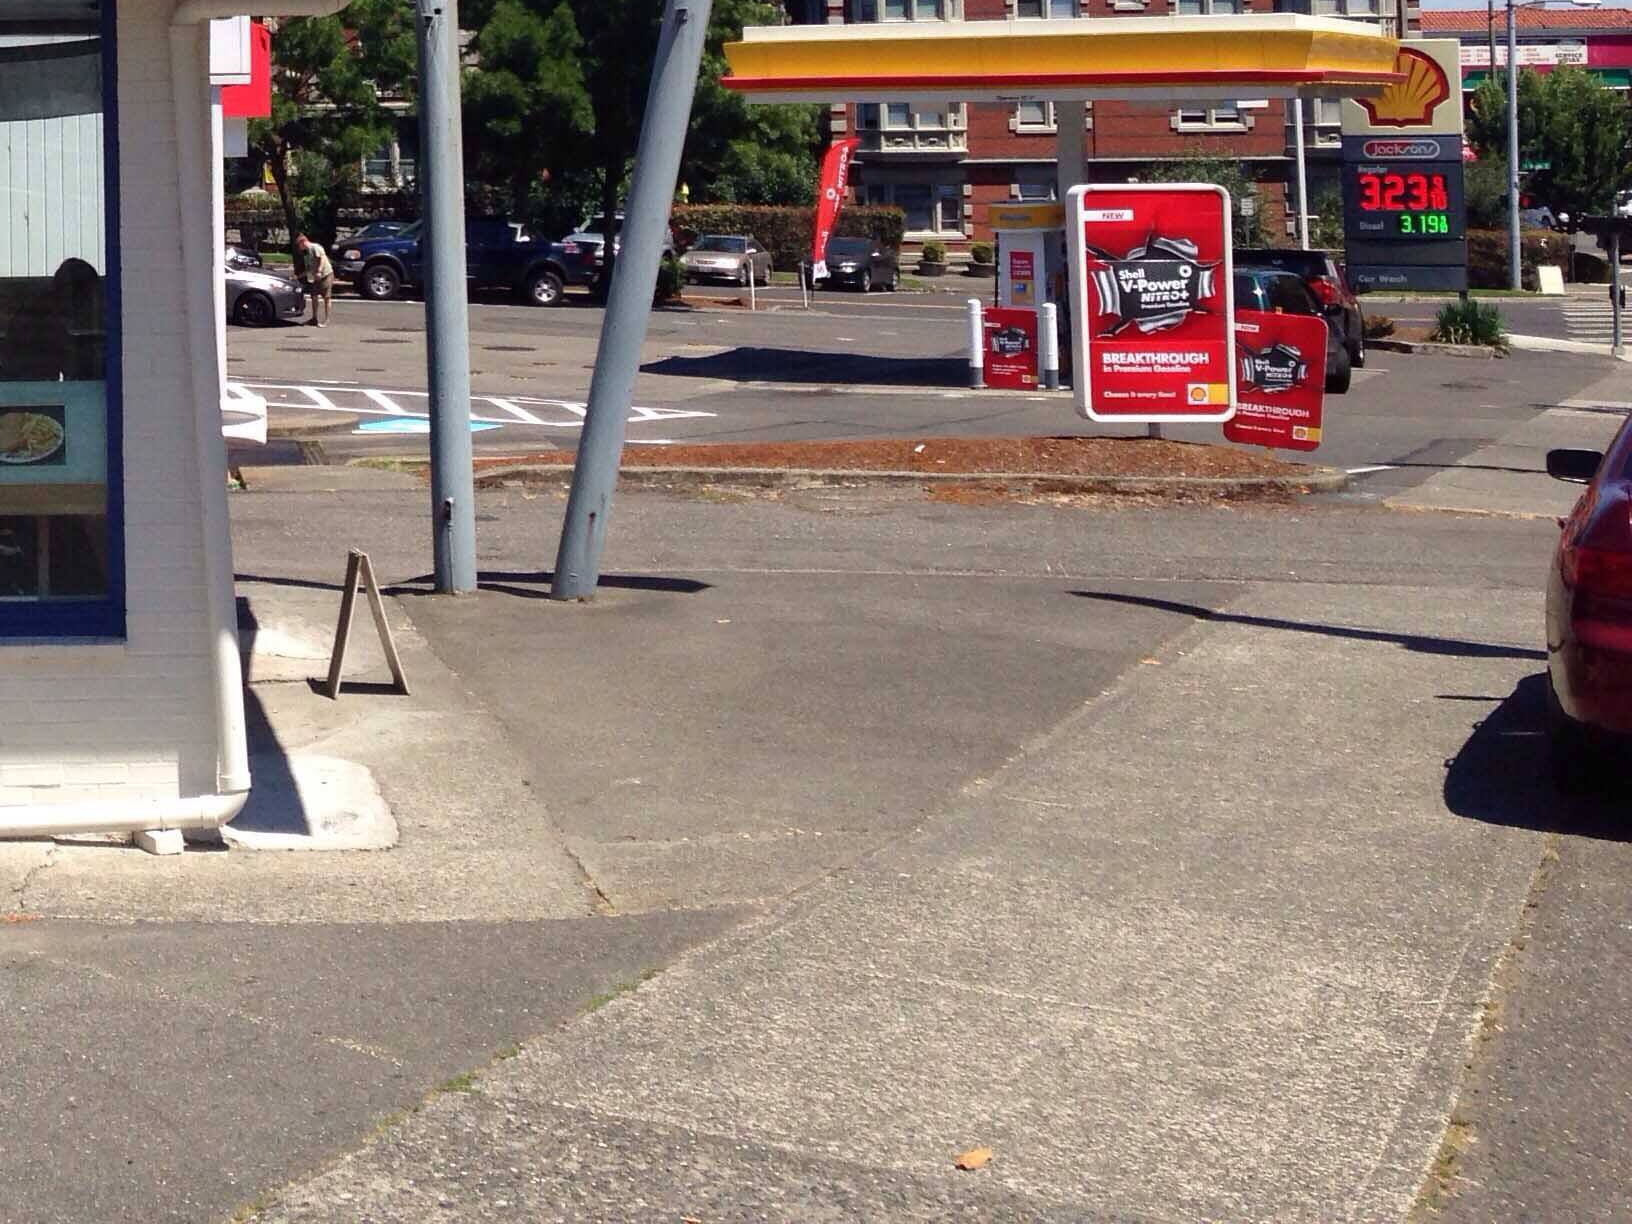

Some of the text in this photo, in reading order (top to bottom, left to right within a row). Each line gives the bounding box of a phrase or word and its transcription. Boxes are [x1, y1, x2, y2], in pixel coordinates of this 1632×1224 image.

[1119, 268, 1145, 280] Shell
[1120, 278, 1189, 293] V-Power
[1102, 352, 1209, 364] BREAKTHROUGH
